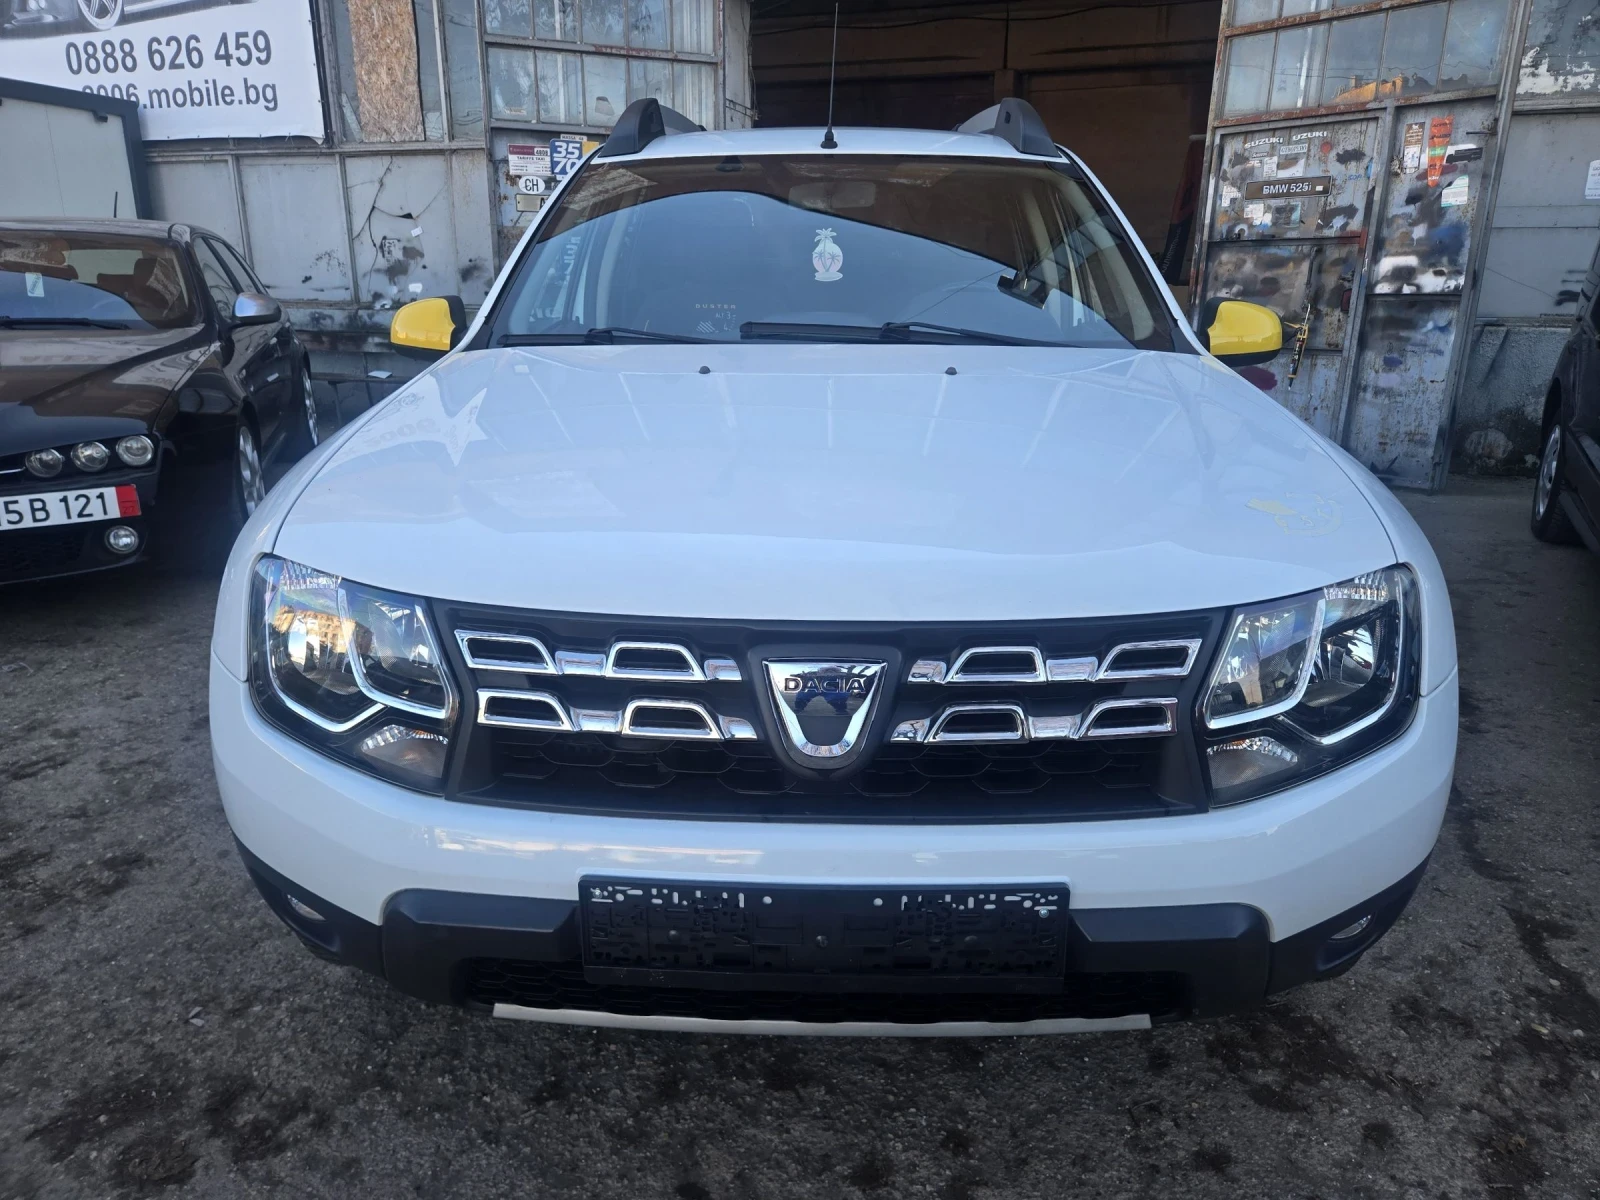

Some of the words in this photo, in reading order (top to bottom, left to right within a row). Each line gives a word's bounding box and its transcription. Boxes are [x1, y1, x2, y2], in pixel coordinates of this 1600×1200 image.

[65, 38, 138, 75] 0888
[147, 34, 204, 71] 626
[214, 29, 272, 67] 459
[553, 141, 580, 158] 35
[1243, 137, 1284, 150] SUZUKI
[524, 178, 540, 192] CH
[1262, 184, 1288, 195] BMW
[1289, 182, 1312, 192] 525i
[0, 498, 25, 526] 5
[29, 498, 51, 523] B
[58, 491, 109, 520] 121
[784, 677, 867, 693] DACIA
